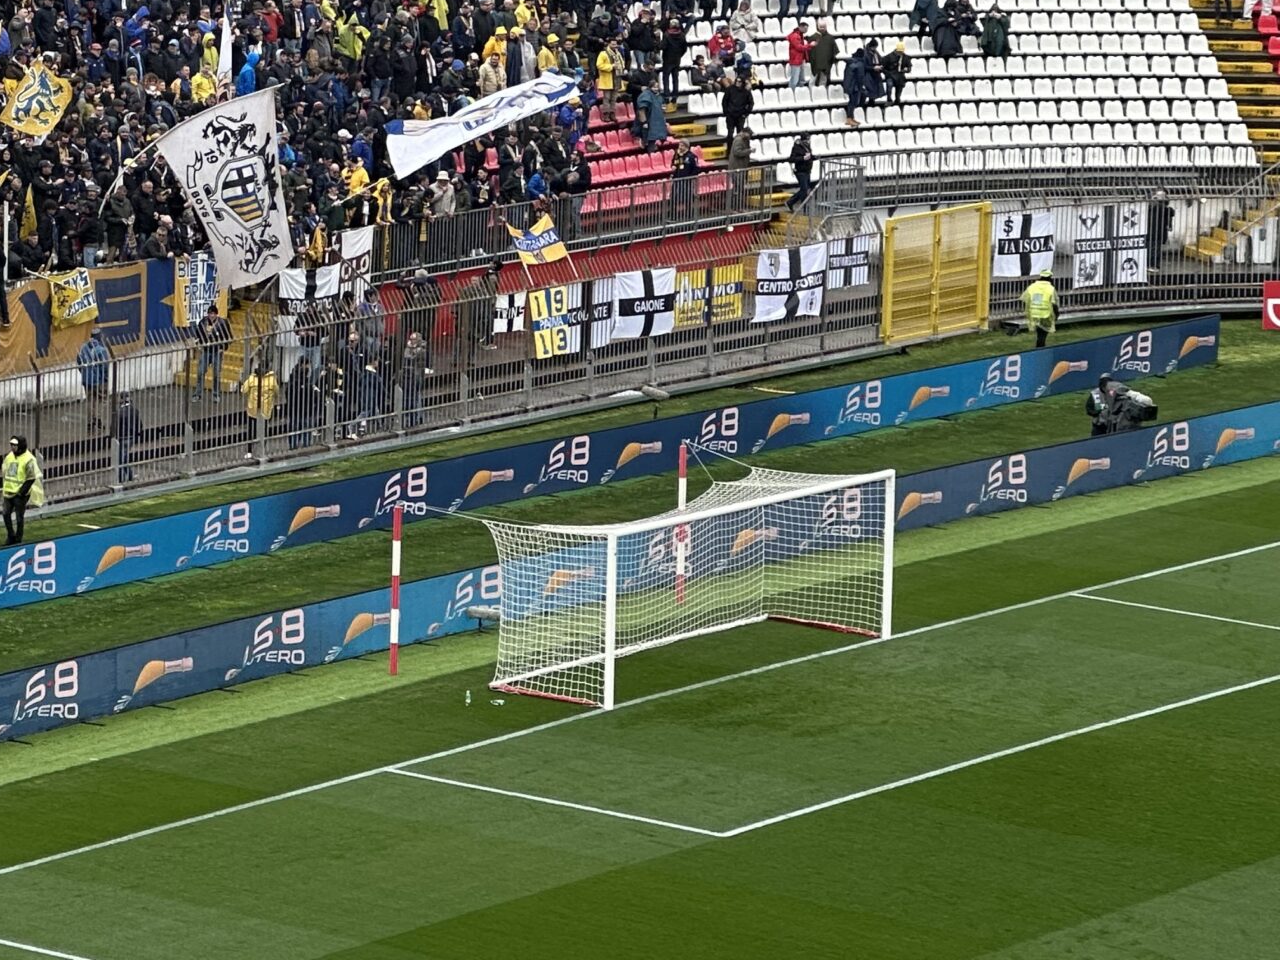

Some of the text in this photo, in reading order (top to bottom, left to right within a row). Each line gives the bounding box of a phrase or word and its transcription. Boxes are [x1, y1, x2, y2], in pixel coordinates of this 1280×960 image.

[191, 190, 211, 219] BOYS
[1020, 237, 1055, 253] ISOLA
[758, 280, 793, 293] CENTRO
[634, 298, 665, 313] GAIONE
